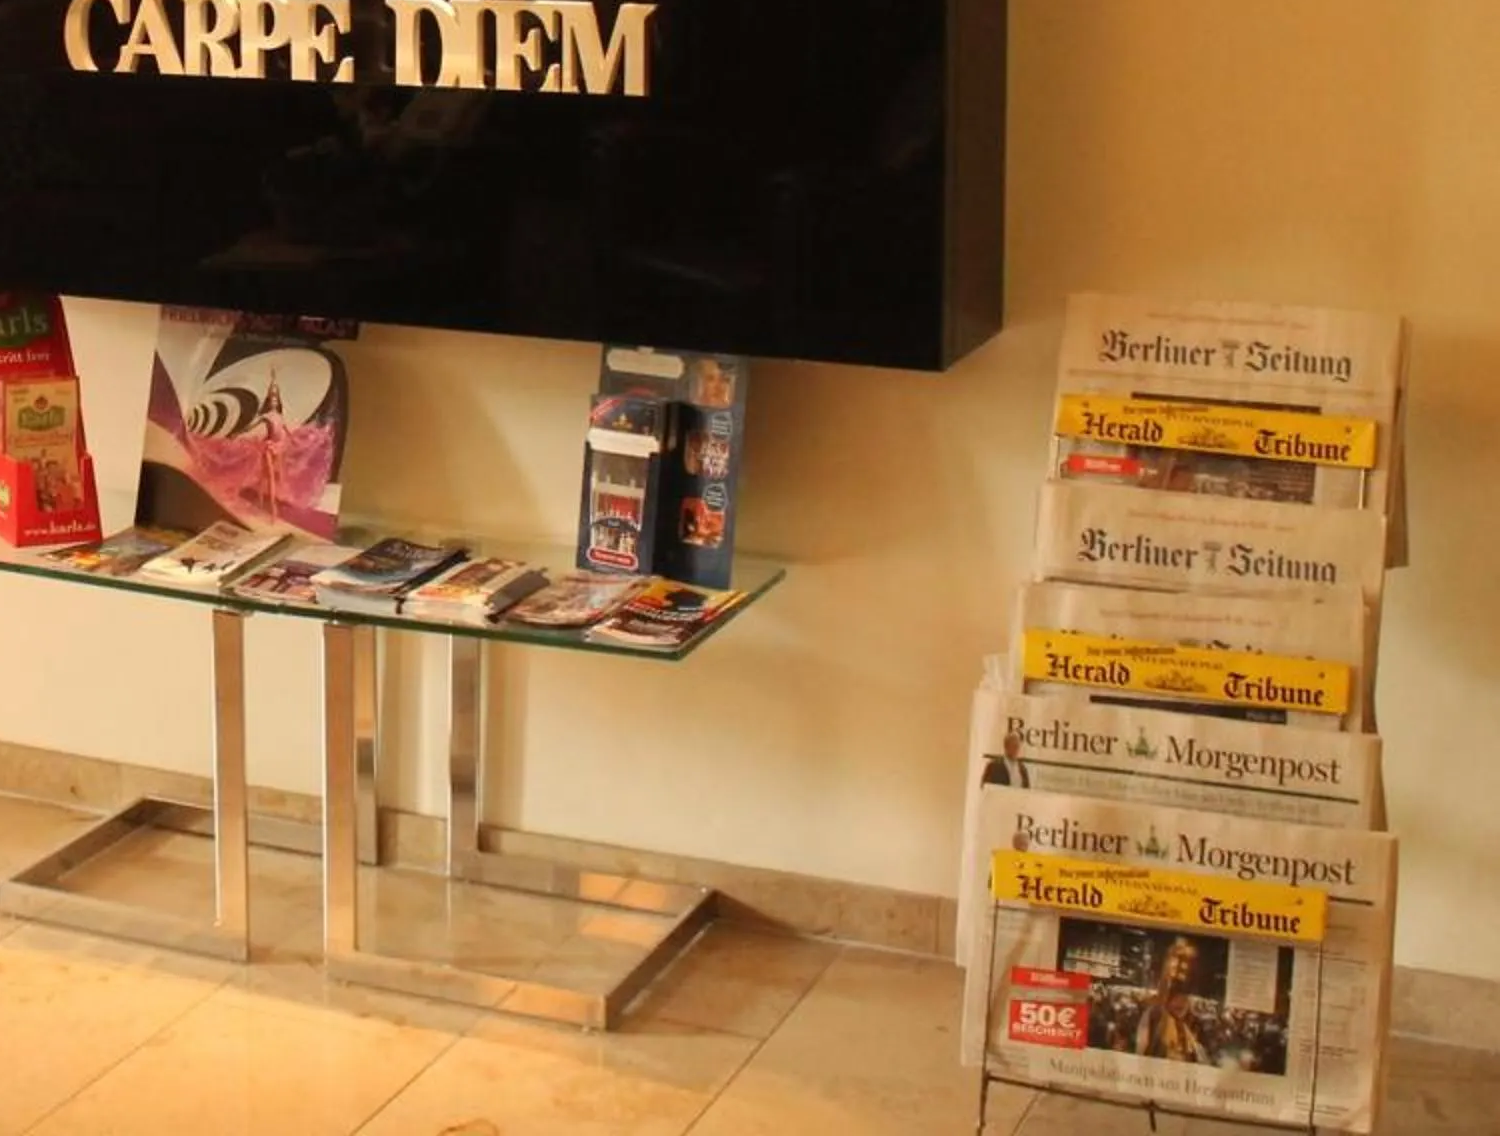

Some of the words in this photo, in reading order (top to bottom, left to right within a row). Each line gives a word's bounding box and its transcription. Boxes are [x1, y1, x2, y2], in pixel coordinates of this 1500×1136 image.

[1099, 329, 1217, 367] Berliner
[1245, 341, 1353, 382] Zeitung
[1081, 411, 1163, 443] Herald
[1254, 428, 1352, 462] Tribune
[1077, 528, 1199, 569] Berliner
[1227, 543, 1338, 585] Zeitung
[1045, 652, 1131, 686] Herald
[1223, 671, 1324, 707] Tribune
[1006, 716, 1118, 756] Berliner
[1164, 735, 1342, 786] Morgenpost
[1015, 813, 1128, 856] Berliner
[1176, 833, 1355, 887] Morgenpost
[1015, 874, 1103, 909] Herald
[1198, 895, 1301, 935] Tribune
[1019, 1001, 1077, 1029] 50€
